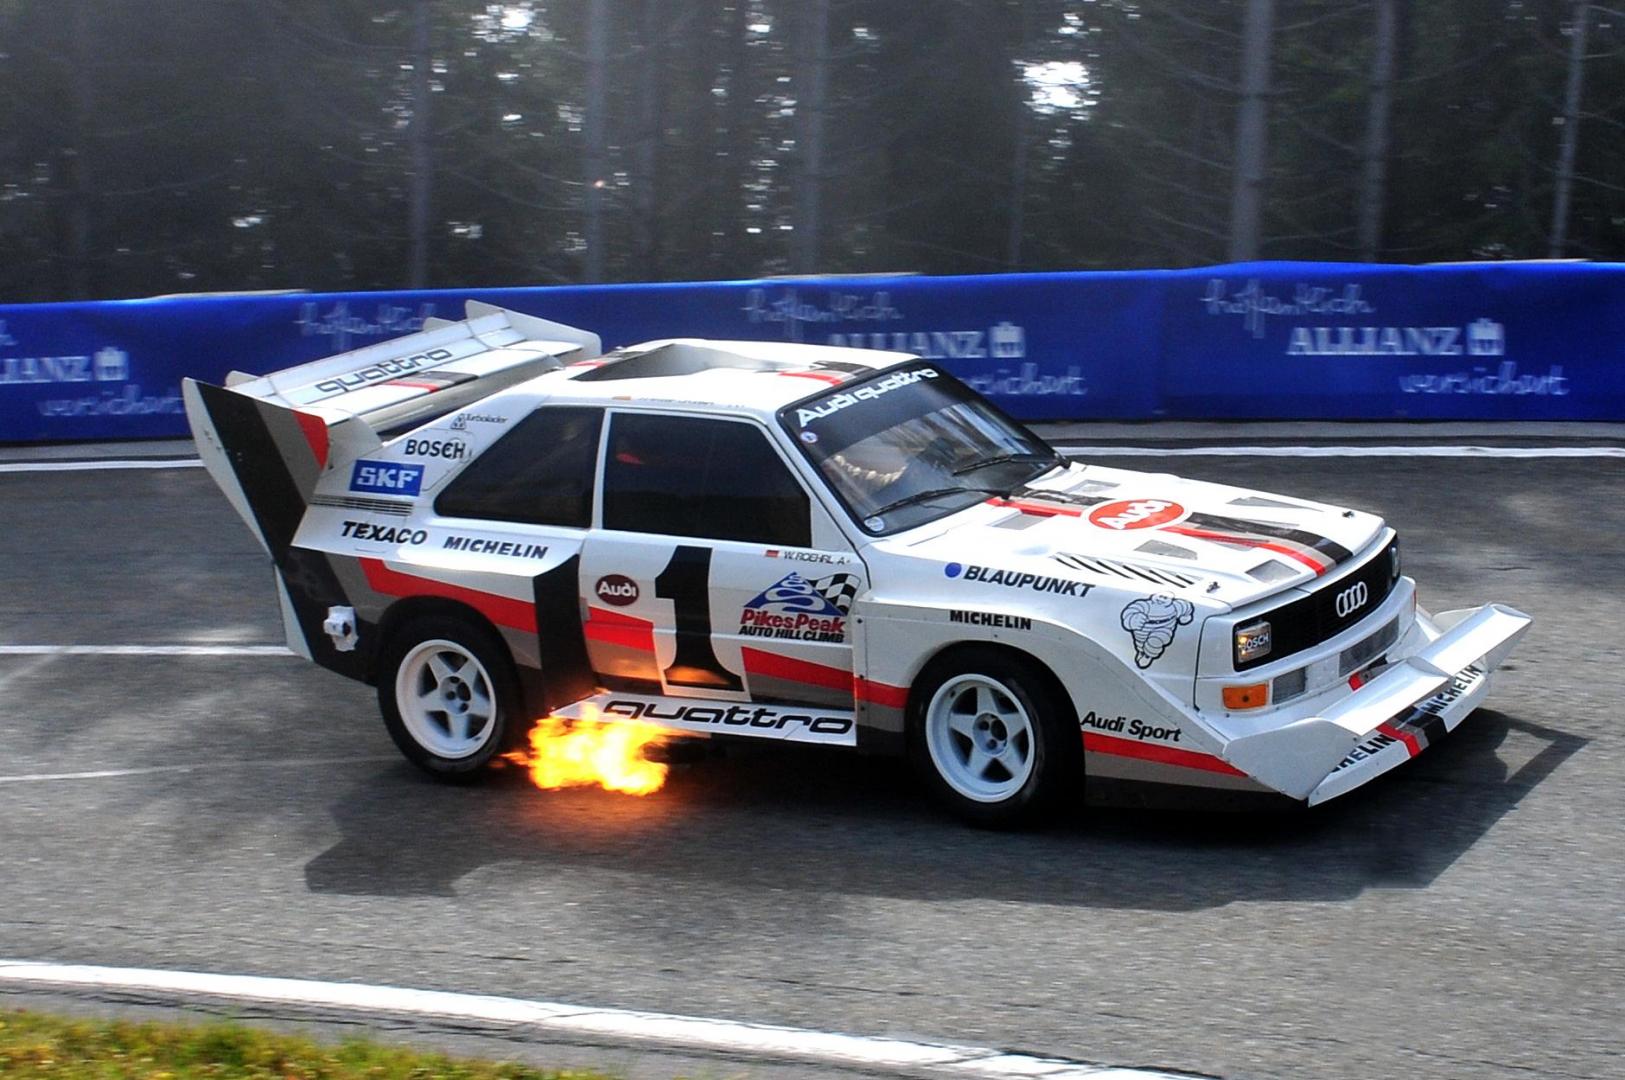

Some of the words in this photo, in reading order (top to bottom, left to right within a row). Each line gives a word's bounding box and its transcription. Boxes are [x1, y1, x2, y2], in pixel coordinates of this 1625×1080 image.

[1285, 327, 1463, 355] ALLIANZ
[315, 348, 453, 393] quattro
[795, 394, 858, 428] Audi
[855, 368, 940, 399] quattro
[404, 439, 466, 459] BOSCH
[356, 466, 419, 489] SKF
[341, 520, 428, 545] TEXACO
[443, 536, 549, 560] MICHELIN
[597, 580, 637, 598] Audi
[963, 565, 1096, 598] BLAUPUNKT
[655, 545, 745, 692] 1
[740, 608, 792, 629] Pikes
[794, 613, 846, 633] Peak
[949, 609, 1032, 631] MICHELIN
[738, 625, 773, 638] AUTO
[774, 628, 801, 640] HILL
[802, 630, 845, 643] CLIMB
[1241, 632, 1269, 651] OSCH
[1420, 664, 1483, 715] MICHELIN
[603, 700, 854, 734] quattro
[1081, 711, 1127, 733] Audi
[1128, 719, 1182, 742] Sport
[1331, 733, 1398, 773] HELIN
